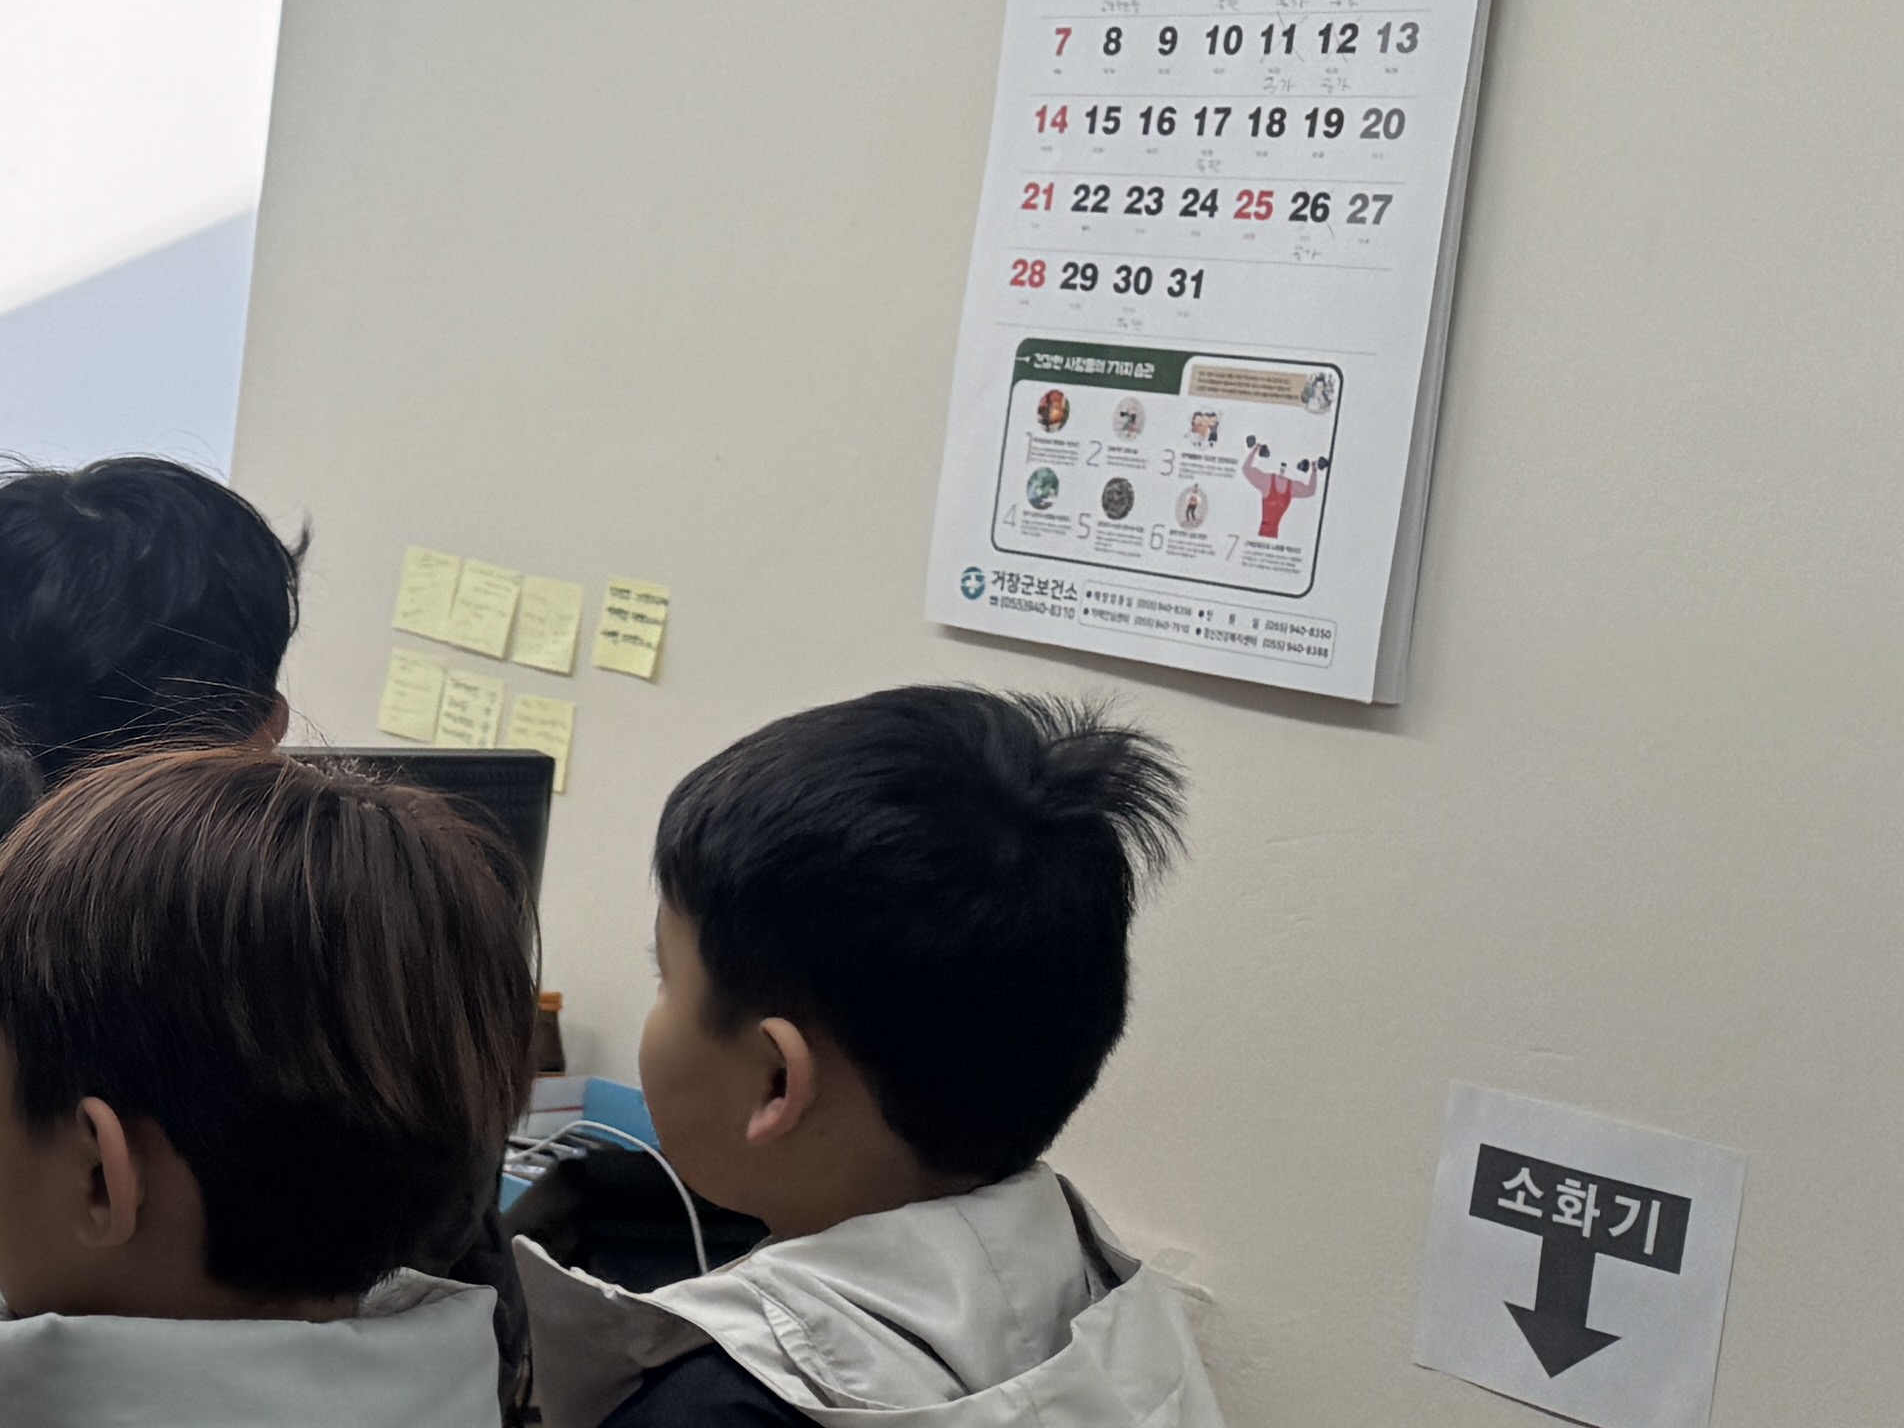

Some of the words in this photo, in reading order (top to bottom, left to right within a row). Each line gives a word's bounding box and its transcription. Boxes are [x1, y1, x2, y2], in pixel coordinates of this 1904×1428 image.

[1056, 28, 1071, 56] 7
[1103, 27, 1122, 55] 8
[1159, 27, 1177, 55] 9
[1206, 25, 1243, 55] 10
[1261, 24, 1296, 54] 11
[1319, 23, 1358, 53] 12
[1377, 22, 1419, 53] 13
[1036, 105, 1068, 133] 14
[1086, 106, 1121, 135] 15
[1140, 106, 1176, 136] 16
[1195, 107, 1231, 136] 17
[1249, 107, 1286, 137] 18
[1305, 108, 1344, 138] 19
[1360, 108, 1405, 140] 20
[1021, 183, 1054, 210] 21
[1071, 184, 1110, 213] 22
[1124, 186, 1164, 215] 23
[1179, 188, 1218, 217] 24
[1234, 190, 1273, 220] 25
[1289, 192, 1330, 223] 26
[1347, 193, 1393, 225] 27
[1010, 259, 1046, 288] 28
[1060, 262, 1098, 291] 29
[1113, 265, 1152, 295] 30
[1167, 268, 1204, 298] 31
[1033, 353, 1064, 370] 건강한
[1134, 362, 1155, 379] 습관
[1086, 440, 1102, 467] 2
[1160, 448, 1175, 476] 3
[1003, 503, 1017, 528] 4
[1077, 512, 1091, 539] 5
[1150, 523, 1165, 550] 6
[1225, 533, 1240, 561] 7
[991, 570, 1077, 601] 거창군보건소
[1497, 1167, 1661, 1255] 소화기
